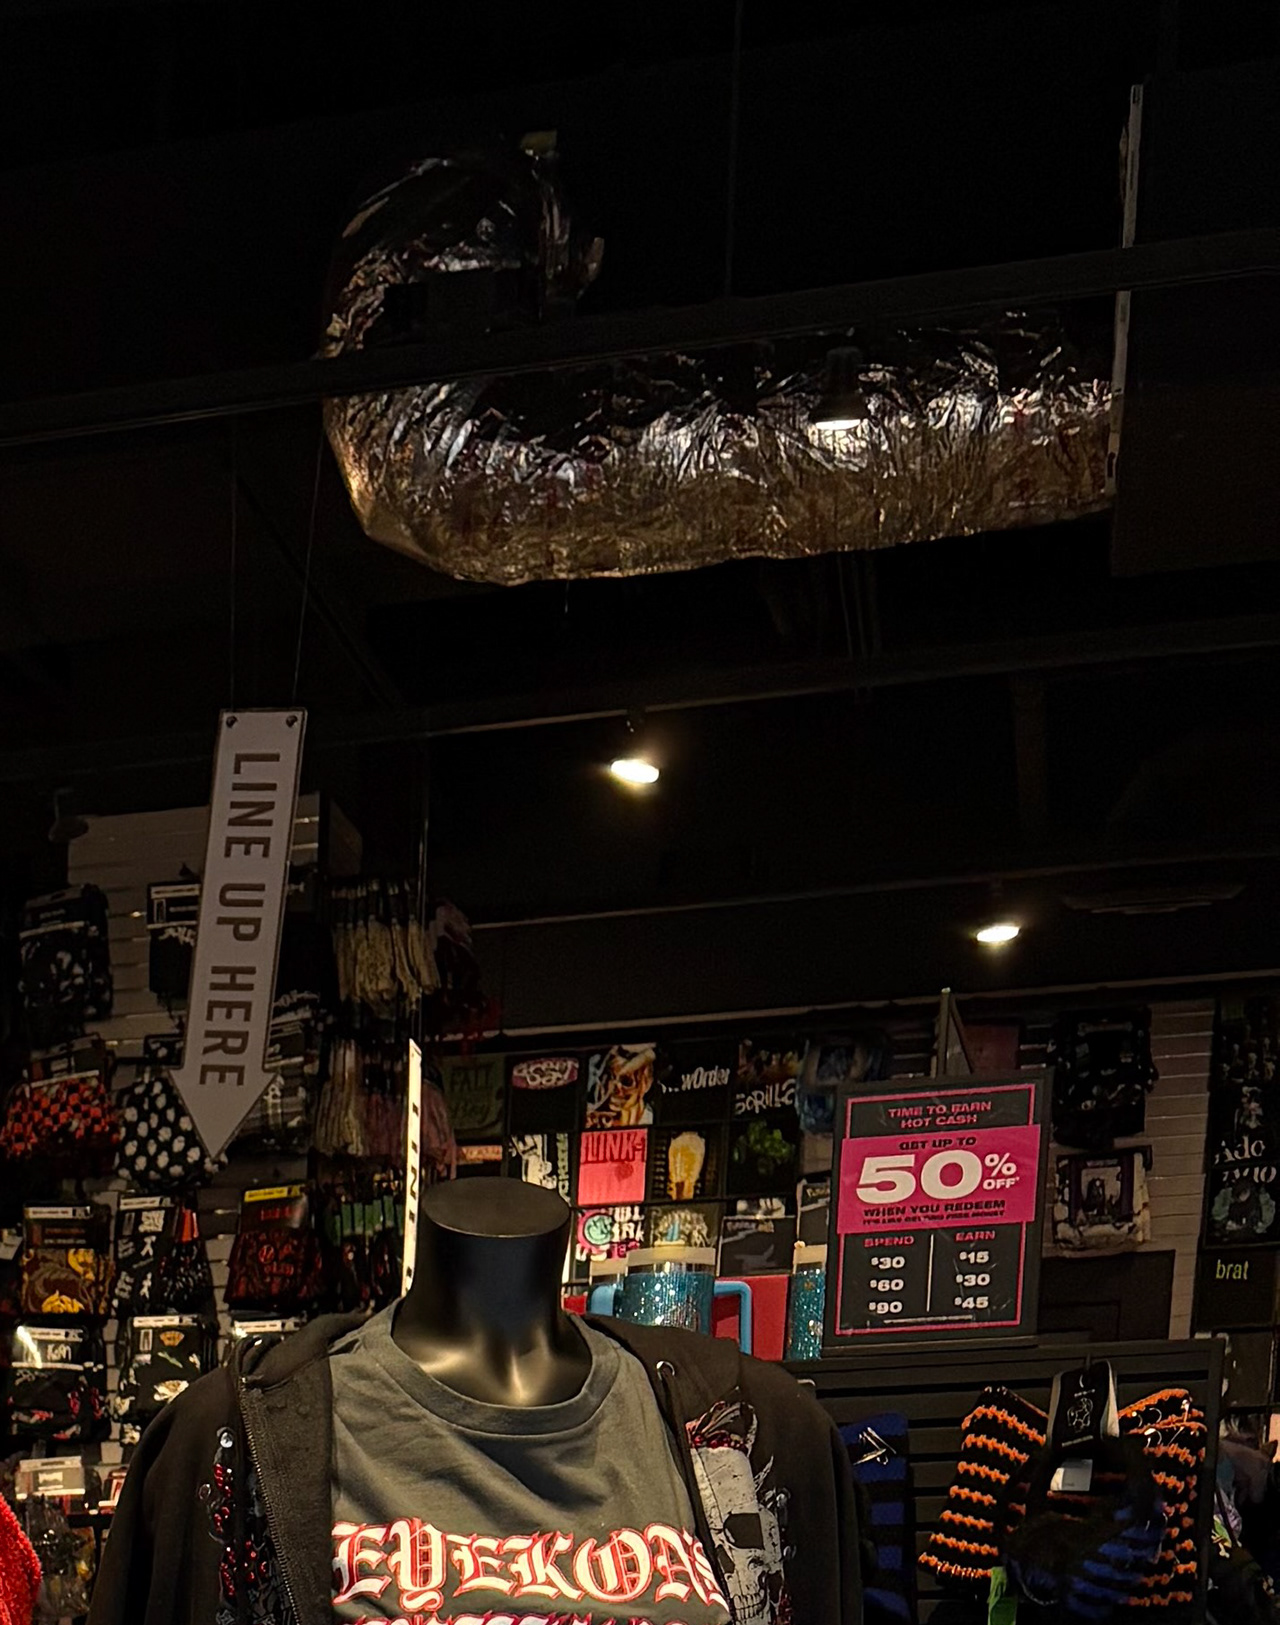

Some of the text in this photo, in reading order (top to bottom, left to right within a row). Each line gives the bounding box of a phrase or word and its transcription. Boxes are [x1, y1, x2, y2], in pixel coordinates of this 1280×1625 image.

[200, 753, 280, 1086] LINE UP HERE
[888, 1102, 991, 1119] TIME TO EARN
[901, 1114, 978, 1128] HOT CASH
[899, 1137, 977, 1150] GET UP TO
[864, 1200, 1006, 1217] WHEN YOU REDEEM
[864, 1236, 914, 1248] SPEND
[956, 1230, 996, 1242] EARN
[871, 1256, 906, 1269] $30
[959, 1251, 990, 1264] $15
[1216, 1259, 1249, 1281] brat
[869, 1278, 904, 1291] $60
[956, 1273, 991, 1287] $30
[868, 1301, 903, 1315] $90
[954, 1296, 989, 1310] $45
